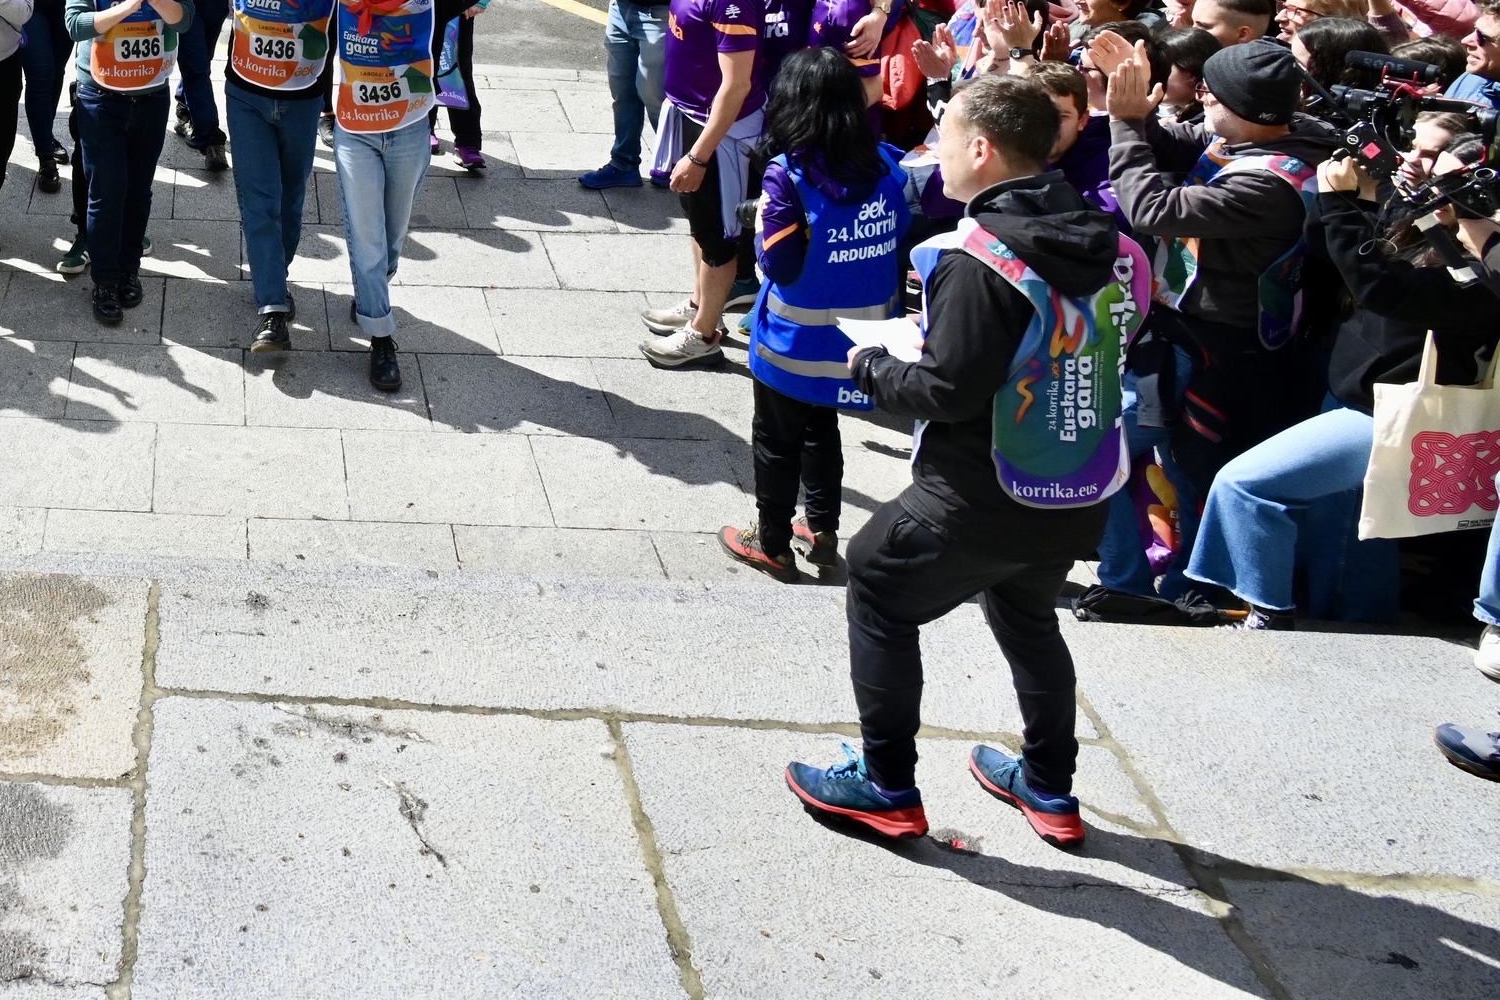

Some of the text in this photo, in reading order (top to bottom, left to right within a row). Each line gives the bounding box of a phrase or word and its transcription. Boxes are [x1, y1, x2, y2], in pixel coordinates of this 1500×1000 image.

[258, 24, 282, 32] LABORAL
[344, 30, 378, 46] Euskara
[120, 37, 161, 60] 3436
[254, 36, 295, 60] 3436
[346, 42, 378, 55] gara
[98, 64, 155, 78] 24.korrika
[233, 56, 316, 78] 24.korrika aek
[360, 70, 385, 78] LABORAL
[358, 82, 401, 103] 3436
[340, 95, 428, 122] 24.korrika aek
[858, 193, 886, 221] aek
[827, 210, 897, 244] 24.korrik
[1060, 359, 1077, 442] Euskara
[1076, 355, 1097, 429] gara
[1047, 380, 1059, 432] 24.korrika
[1012, 480, 1098, 498] korrika.eus
